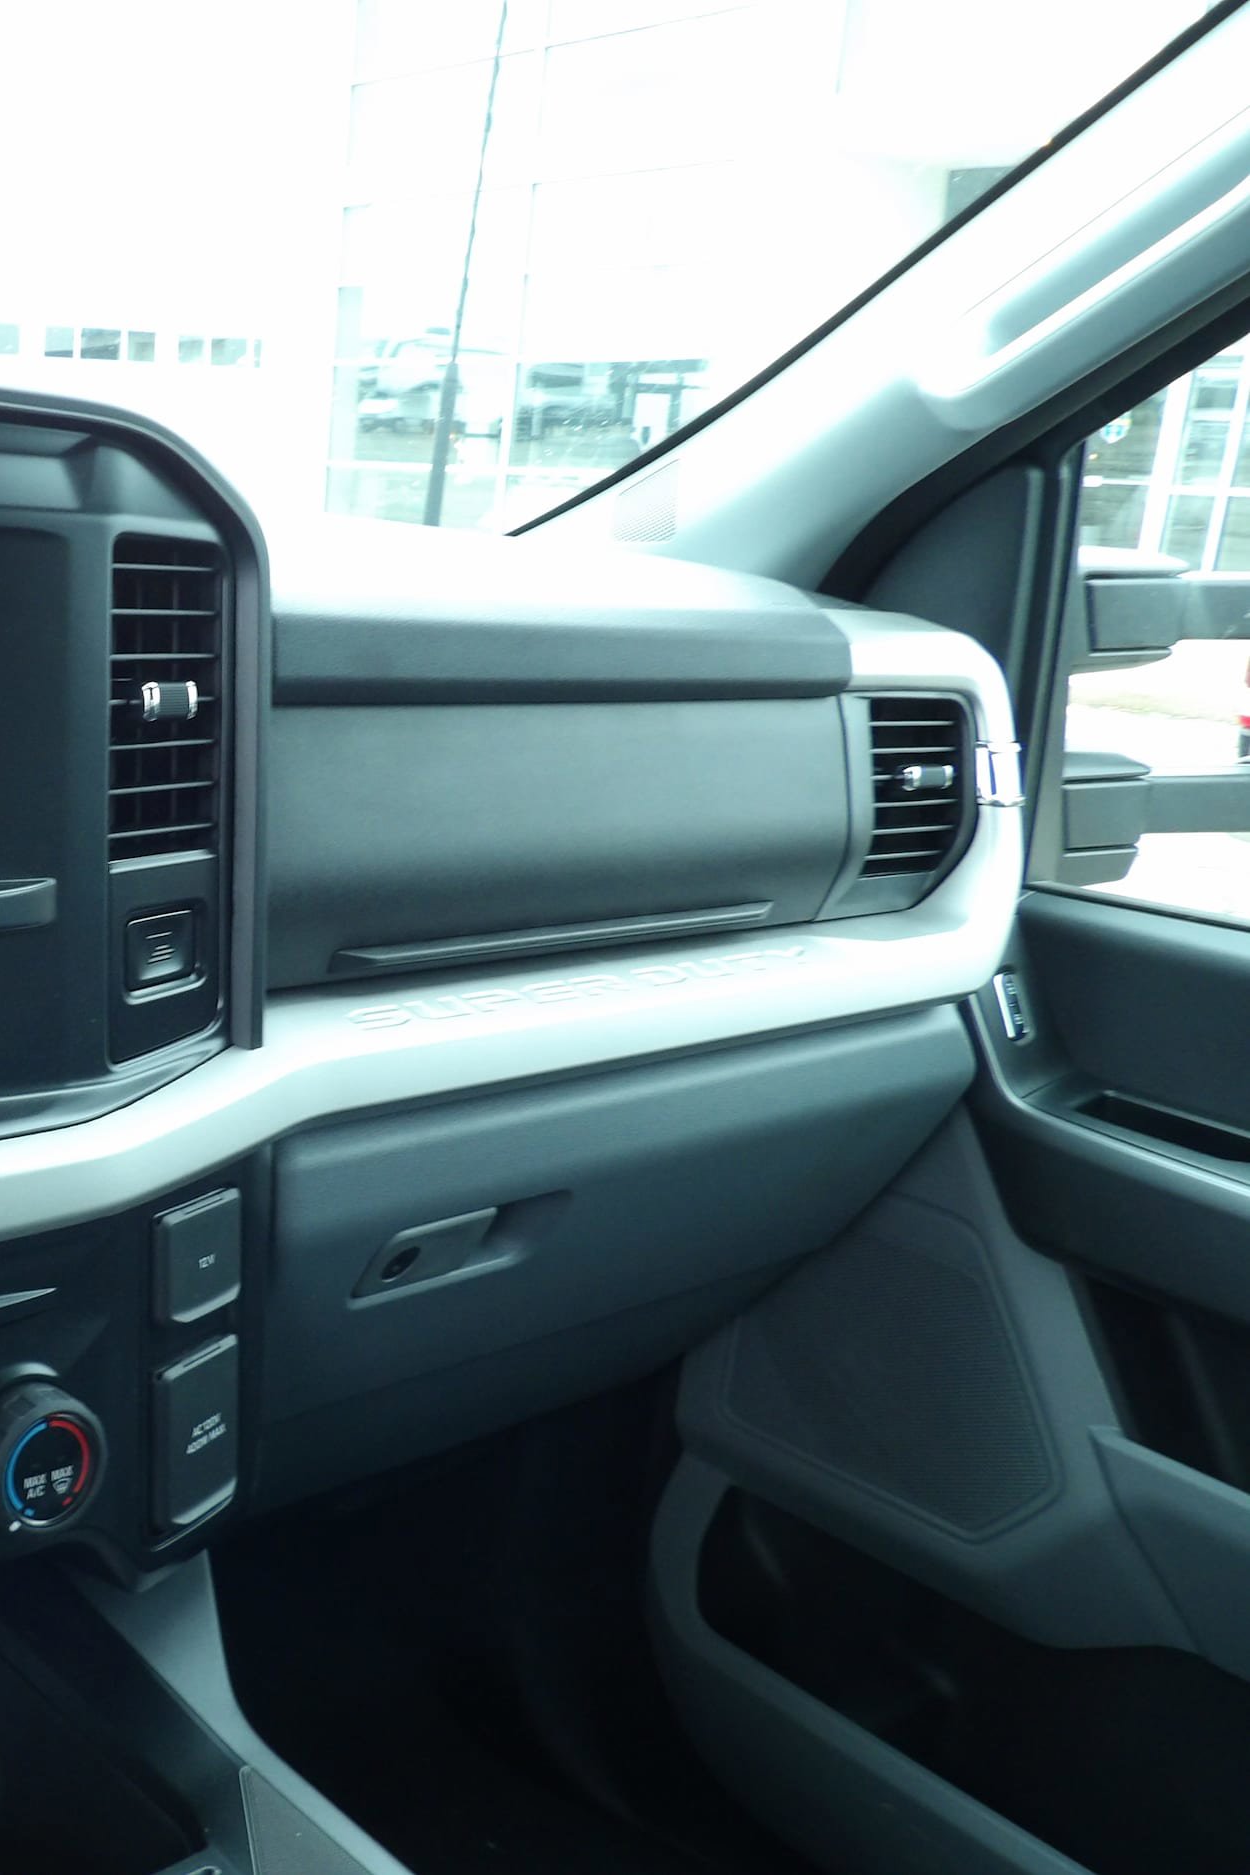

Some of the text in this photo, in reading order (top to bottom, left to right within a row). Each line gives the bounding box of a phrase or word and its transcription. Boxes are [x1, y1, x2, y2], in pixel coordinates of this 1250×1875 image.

[344, 944, 806, 1031] SUPER DUTY
[50, 1464, 74, 1481] MAX
[23, 1473, 48, 1490] MAX
[26, 1485, 47, 1500] A/C
